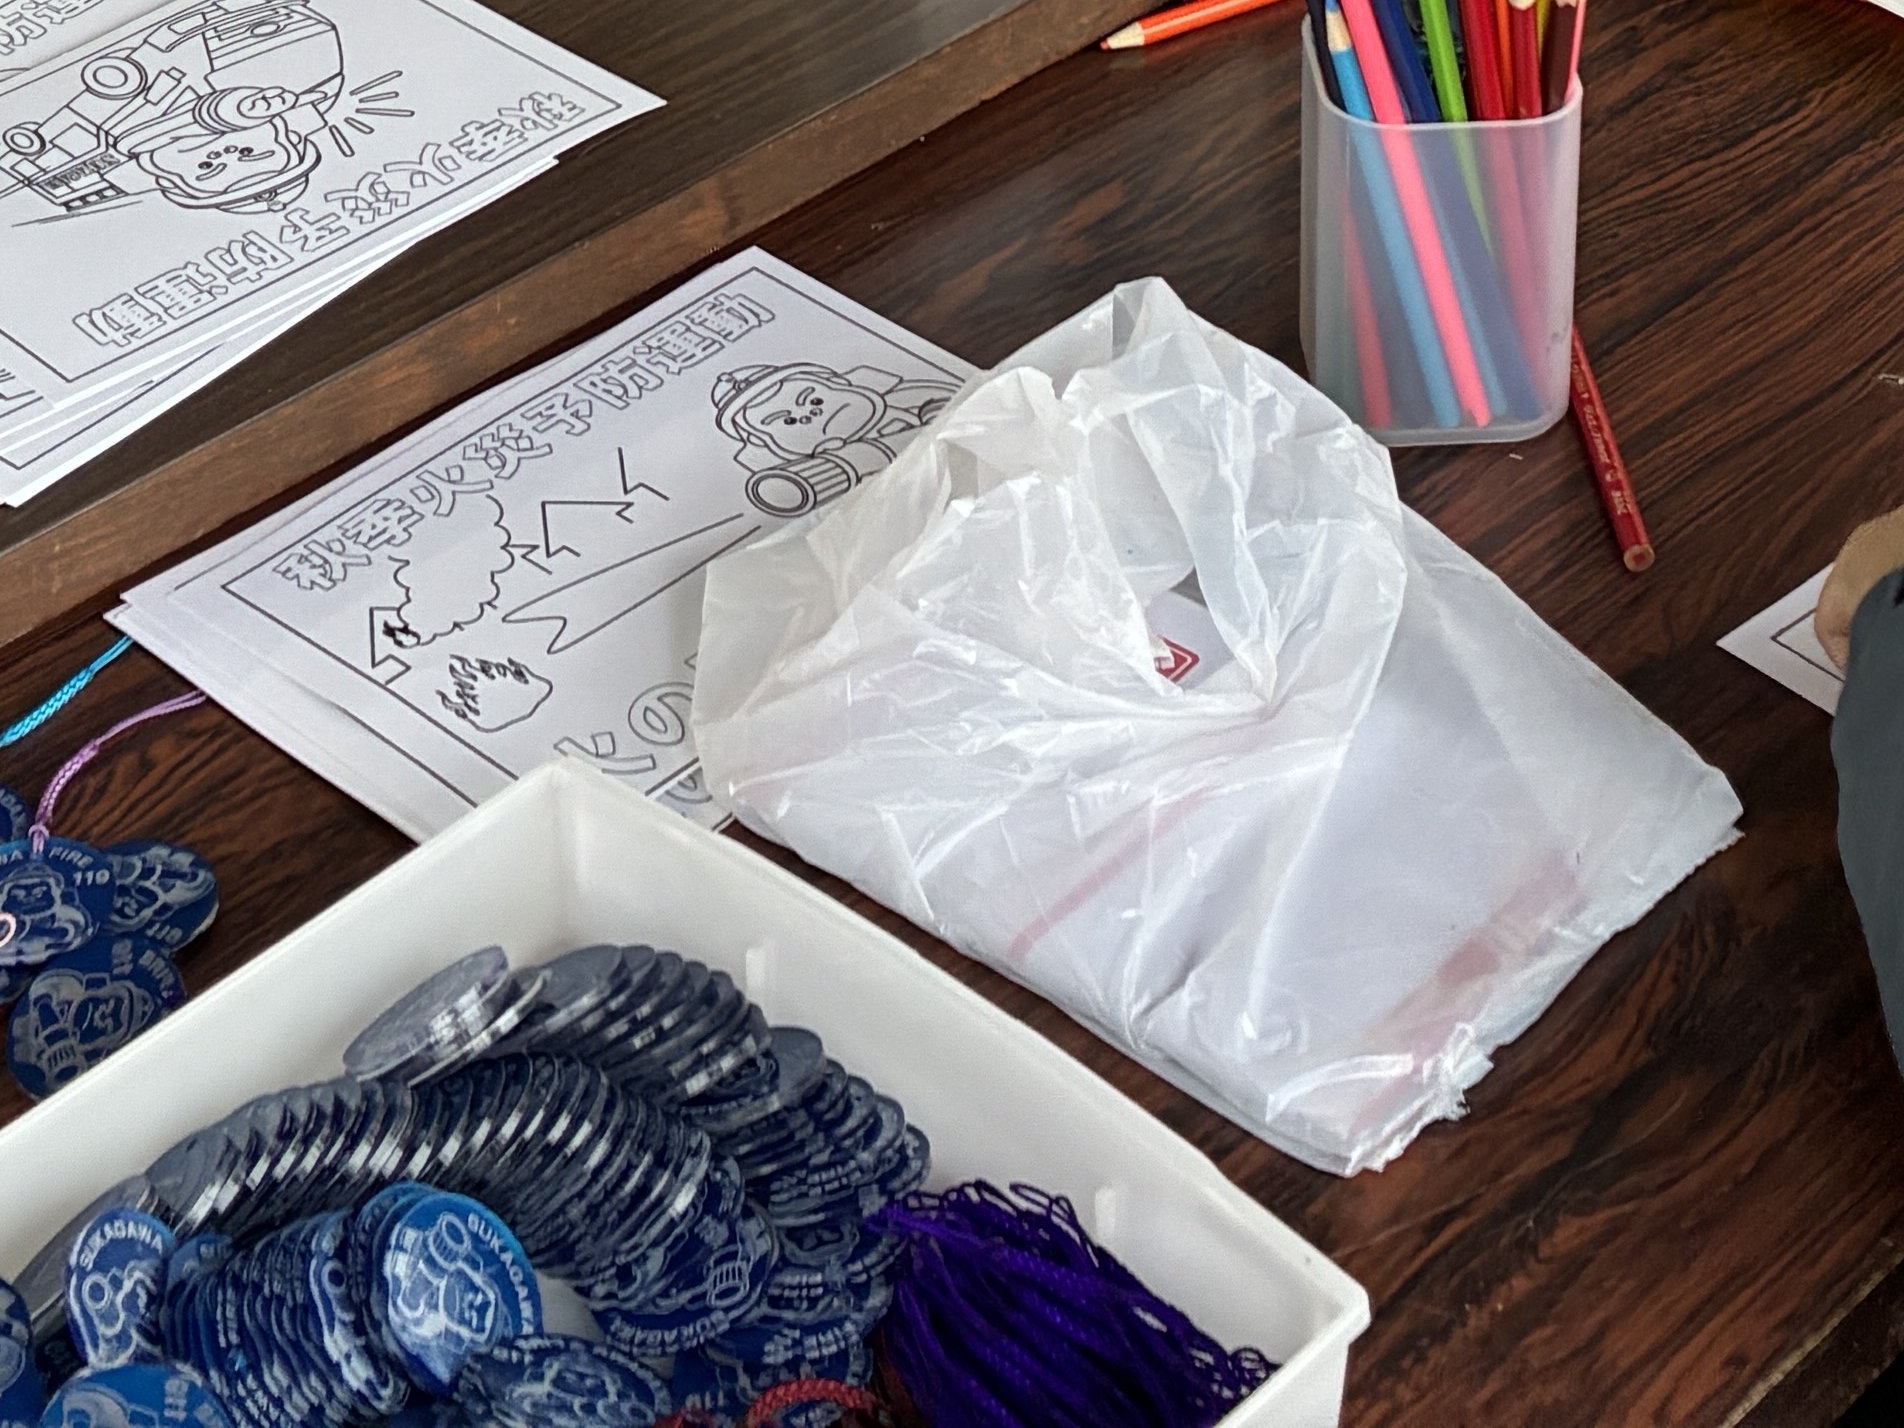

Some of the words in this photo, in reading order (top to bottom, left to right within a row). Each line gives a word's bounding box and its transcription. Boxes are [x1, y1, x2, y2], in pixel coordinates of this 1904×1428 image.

[70, 88, 590, 350] 秋季火災予防運動
[274, 291, 778, 594] 秋季火災予防運動
[554, 681, 702, 776] 火の
[49, 845, 94, 868] FIRE
